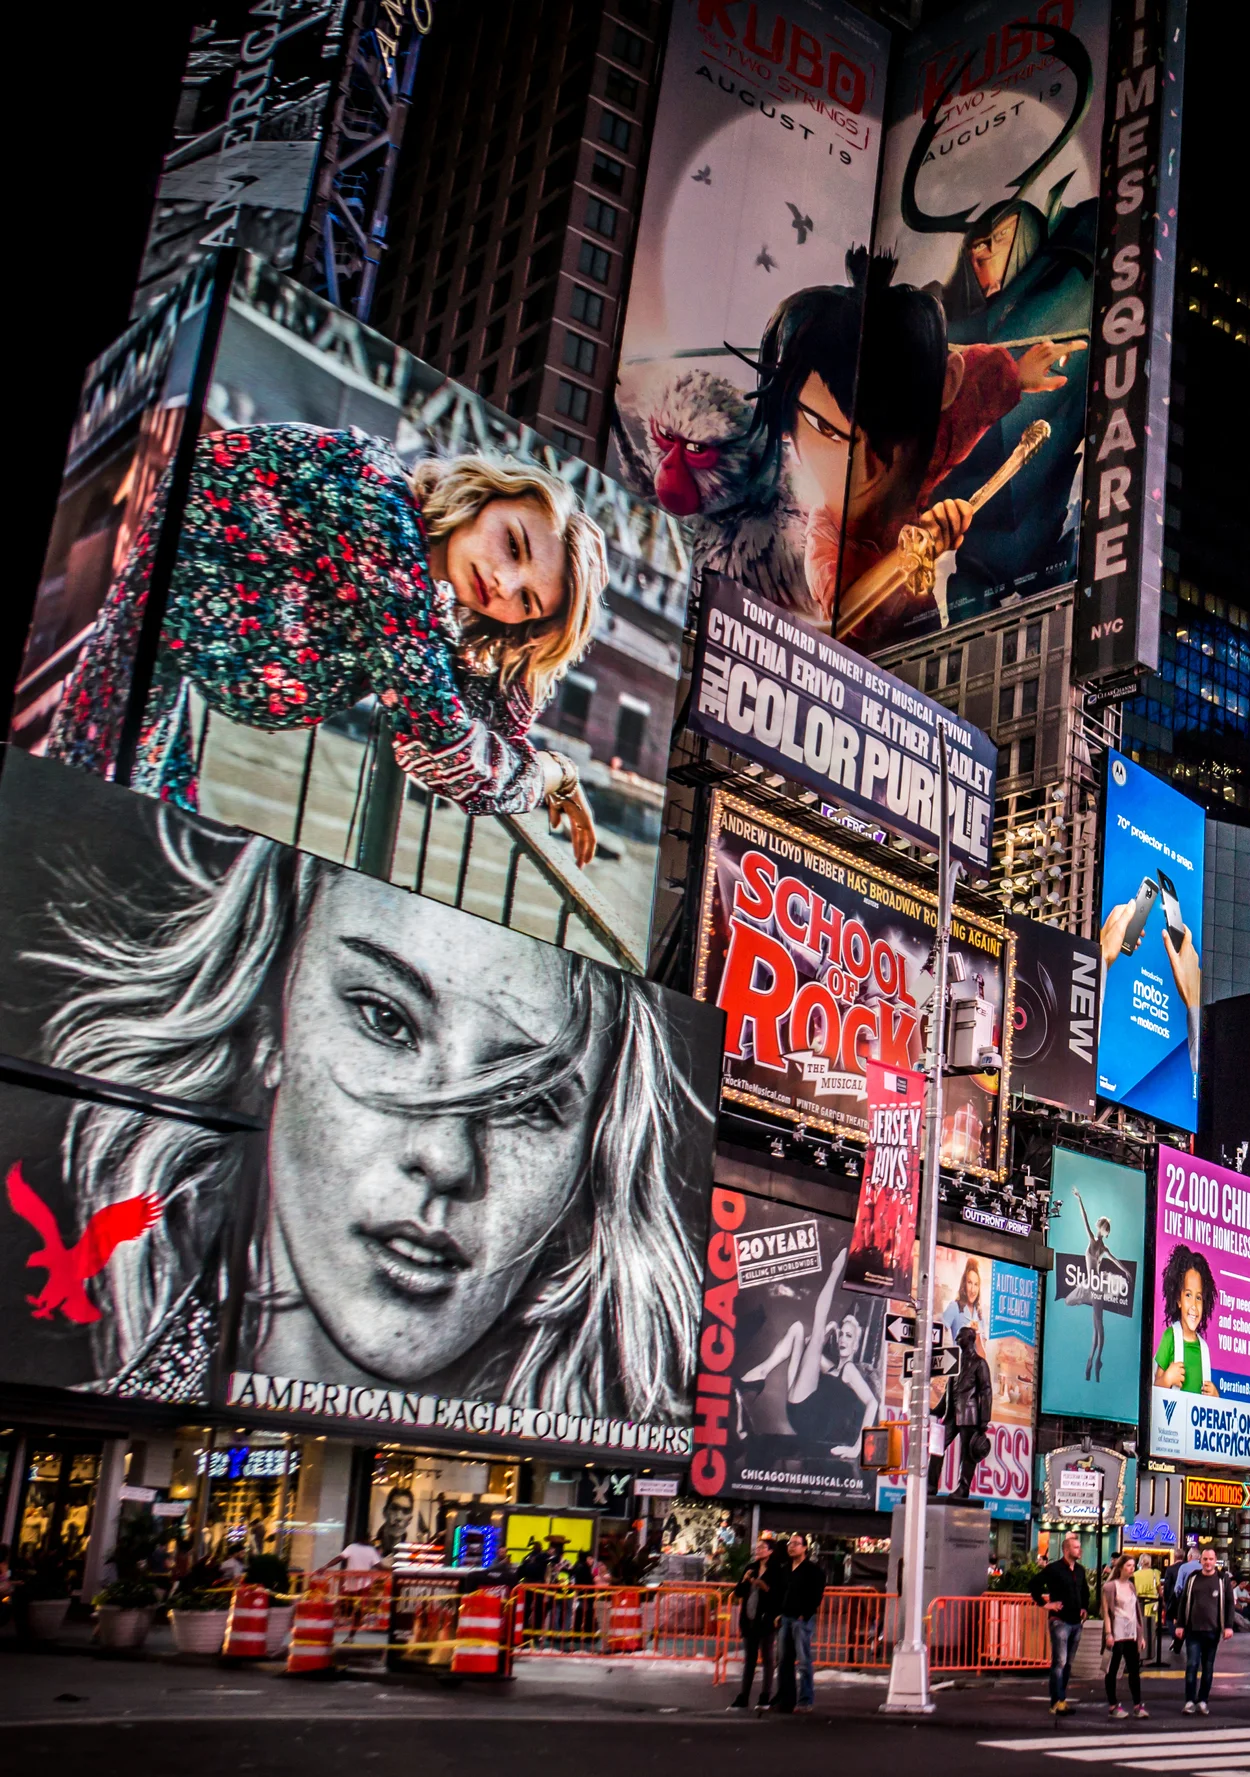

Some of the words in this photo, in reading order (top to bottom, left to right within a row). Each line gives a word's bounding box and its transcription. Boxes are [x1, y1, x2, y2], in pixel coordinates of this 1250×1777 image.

[690, 0, 866, 115] KUBO
[724, 41, 771, 80] TWO
[778, 75, 859, 136] STRINGS
[696, 65, 814, 140] AUGUST
[829, 143, 852, 165] 19
[922, 100, 1024, 166] AUGUST
[1039, 82, 1062, 104] 19
[1094, 243, 1146, 582] SQUARE
[1091, 618, 1123, 641] NYC
[742, 598, 775, 631] TONY
[776, 620, 815, 655] AWARD
[819, 645, 863, 683] WINNER!
[865, 668, 890, 699] BEST
[892, 684, 934, 727] MUSICAL
[699, 652, 731, 724] THE
[708, 608, 787, 679] CYNTHIA
[791, 659, 845, 710] ERIVO
[860, 694, 930, 760] HEATHER
[726, 660, 862, 793] COLOR
[861, 734, 991, 861] PURPLE
[1131, 825, 1162, 851] projector
[1163, 842, 1170, 856] in
[721, 811, 767, 849] ANDREW
[769, 832, 801, 864] LLOYD
[804, 846, 844, 884] WEBBER
[846, 872, 868, 895] HAS
[869, 883, 921, 920] BROADWAY
[924, 909, 966, 941] ROING
[734, 850, 915, 1009] SCHOOL
[717, 916, 917, 1072] ROCK
[827, 969, 859, 1004] OF
[1068, 951, 1097, 1064] NEW
[807, 1063, 825, 1074] THE
[821, 1077, 863, 1090] MUSICAL
[796, 1098, 819, 1113] WINTER
[870, 1108, 921, 1147] JERSEY
[872, 1146, 908, 1191] BOYS
[1165, 1163, 1218, 1219] 22,000
[965, 1209, 1005, 1229] OUTFRONT
[1164, 1209, 1183, 1236] LIVE
[1184, 1217, 1194, 1239] IN
[1195, 1220, 1212, 1247] NYC
[738, 1240, 763, 1262] 20
[765, 1226, 816, 1257] YEARS
[745, 1267, 770, 1280] KILLING
[770, 1265, 775, 1275] IT
[777, 1259, 814, 1273] WORLDWIDE
[1065, 1264, 1128, 1296] StubHub
[1219, 1290, 1234, 1312] They
[691, 1187, 747, 1497] CHICAGO
[1219, 1315, 1232, 1330] and
[1219, 1333, 1232, 1351] YOU
[1234, 1336, 1246, 1355] CAN
[231, 1371, 421, 1424] AMERICAN
[433, 1396, 523, 1436] EAGLE
[531, 1408, 693, 1455] OUTFITTERS
[1194, 1430, 1250, 1457] BACKPACK
[740, 1468, 864, 1489] CHICAGOTHEMUSICAL.COM
[1189, 1482, 1205, 1501] DOS
